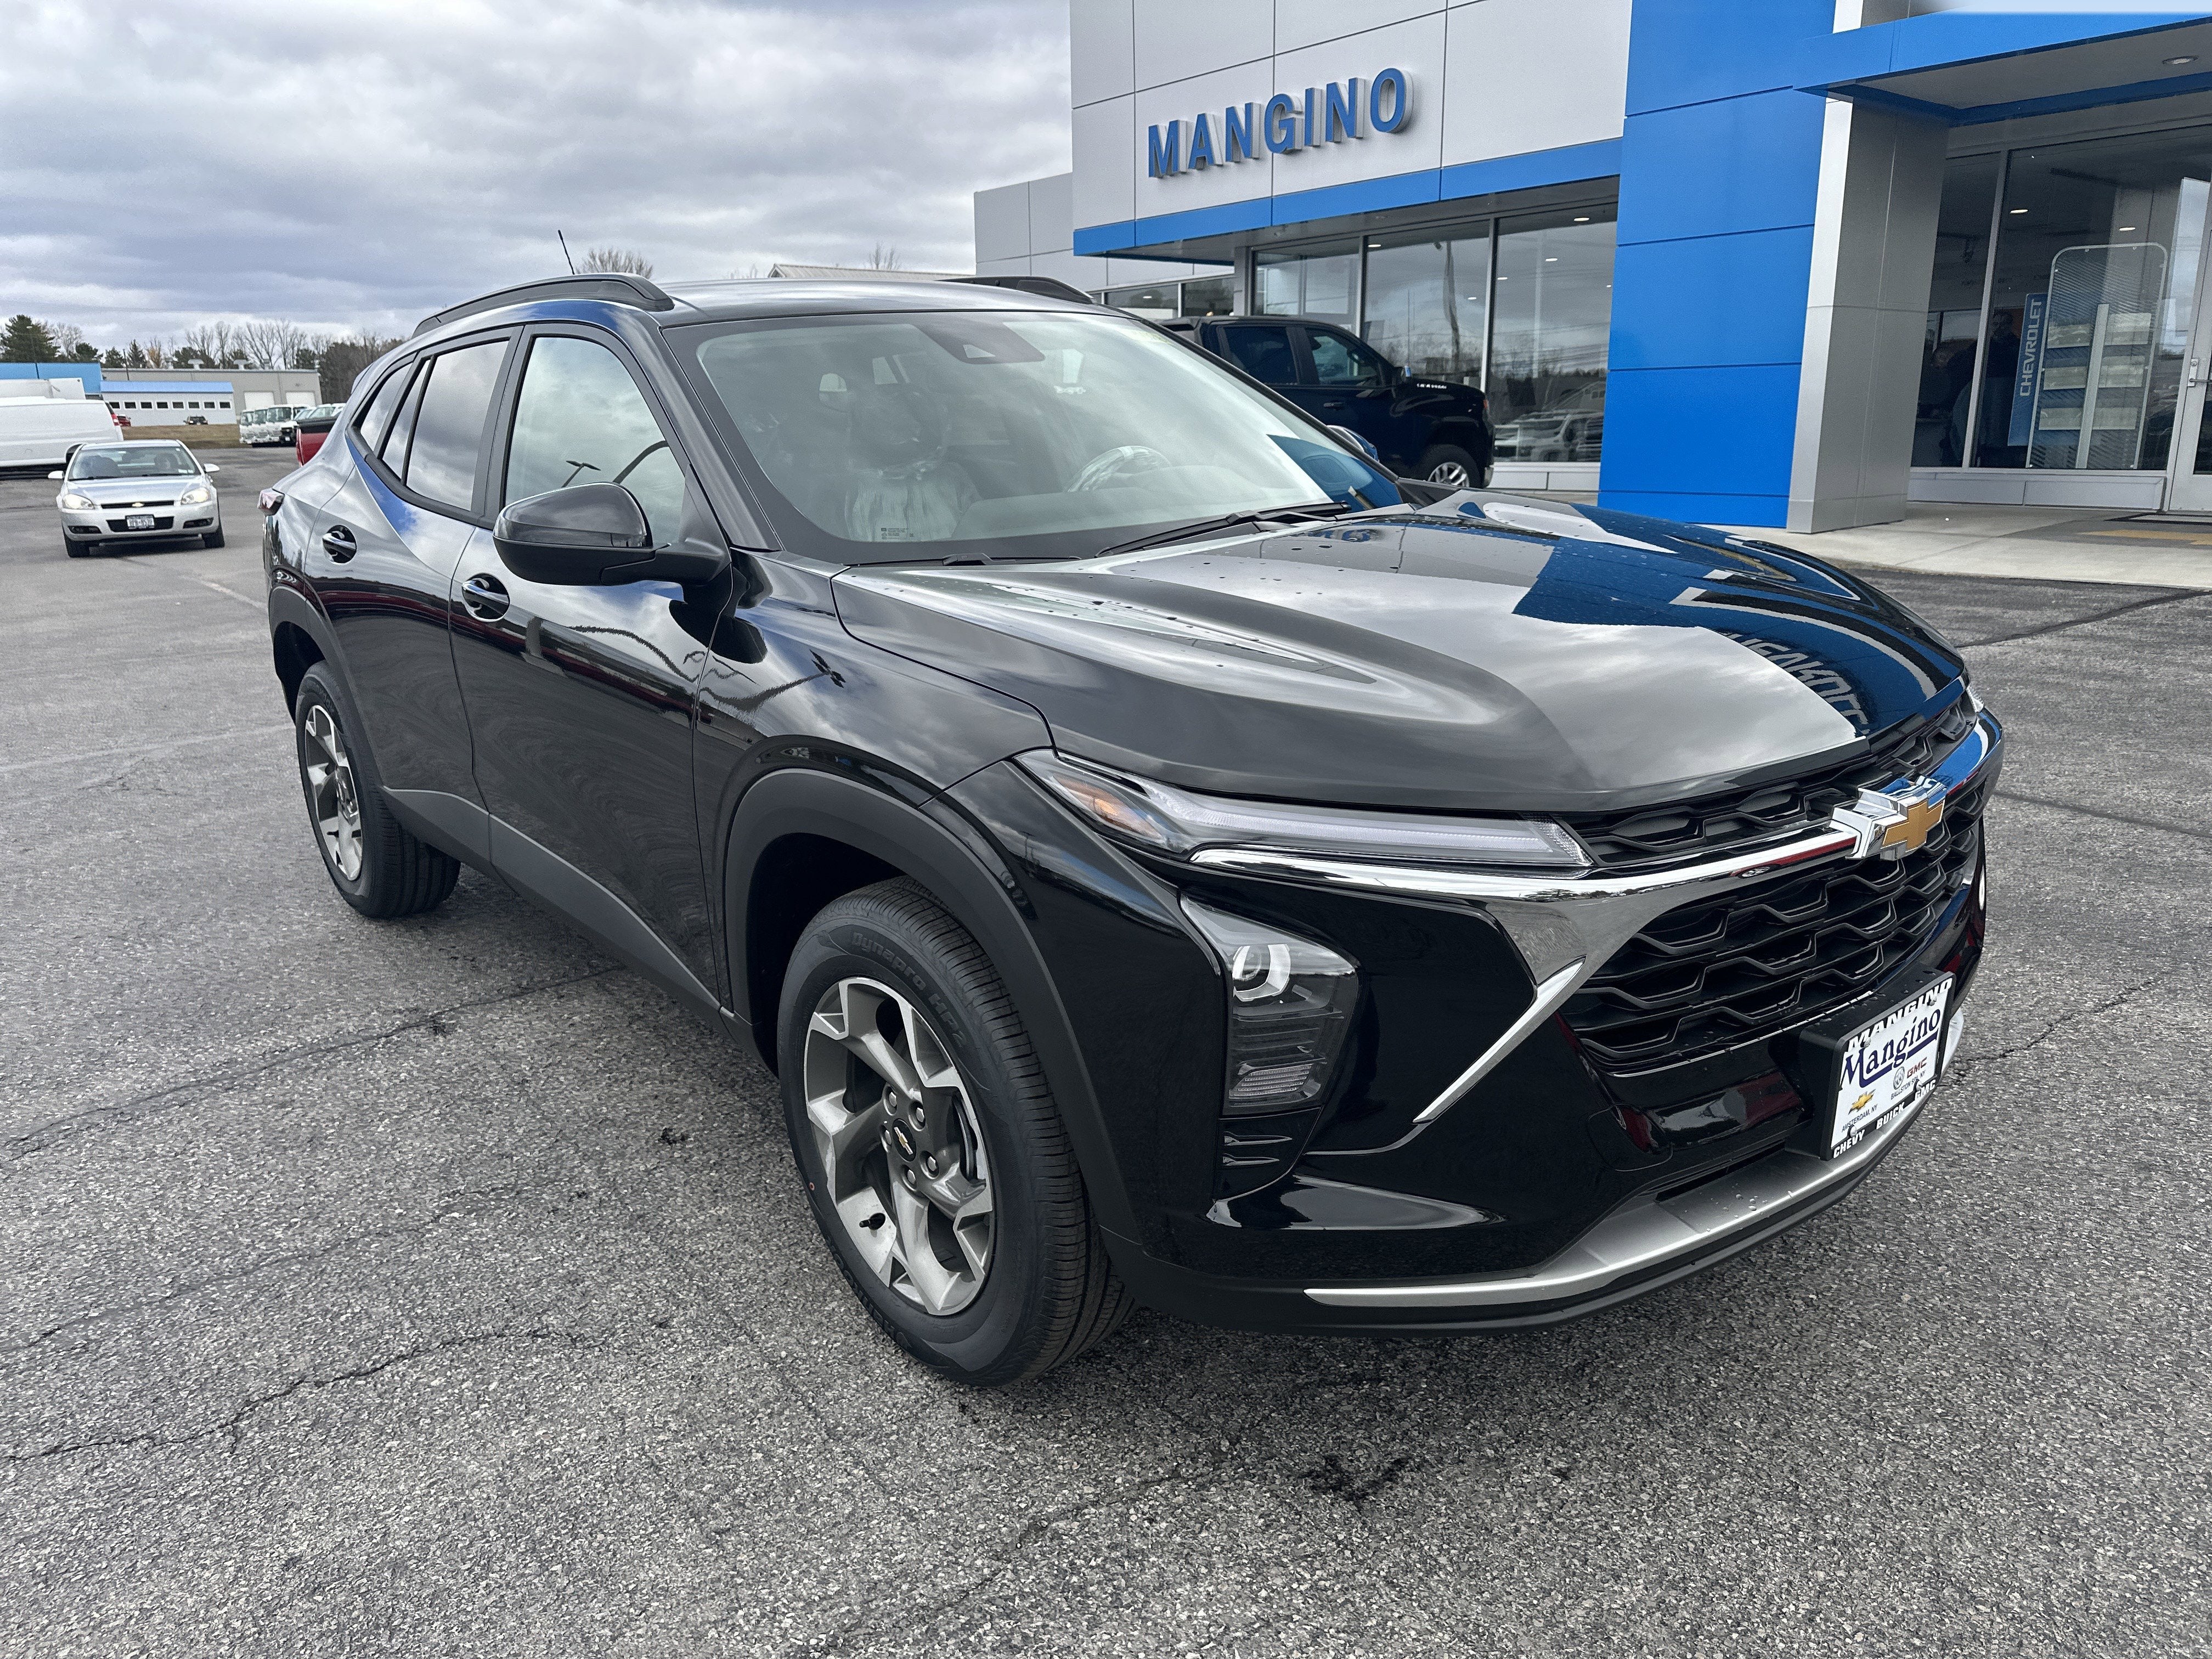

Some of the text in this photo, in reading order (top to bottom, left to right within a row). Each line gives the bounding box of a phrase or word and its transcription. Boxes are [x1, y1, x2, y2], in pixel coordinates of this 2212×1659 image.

[1148, 67, 1414, 178] MANGINO
[2019, 298, 2042, 396] CHEVROLET
[852, 932, 926, 990] Dynapro
[1839, 1009, 1941, 1088] Mangino
[1848, 978, 1953, 1053] MANGINO
[1891, 1081, 1911, 1100] BALLSTON
[1920, 1070, 1926, 1078] NY
[1906, 1057, 1927, 1079] GMC
[1833, 1079, 1936, 1159] CHEVY BUICK GMC
[1841, 1104, 1878, 1133] AMSTERDAM, NY
